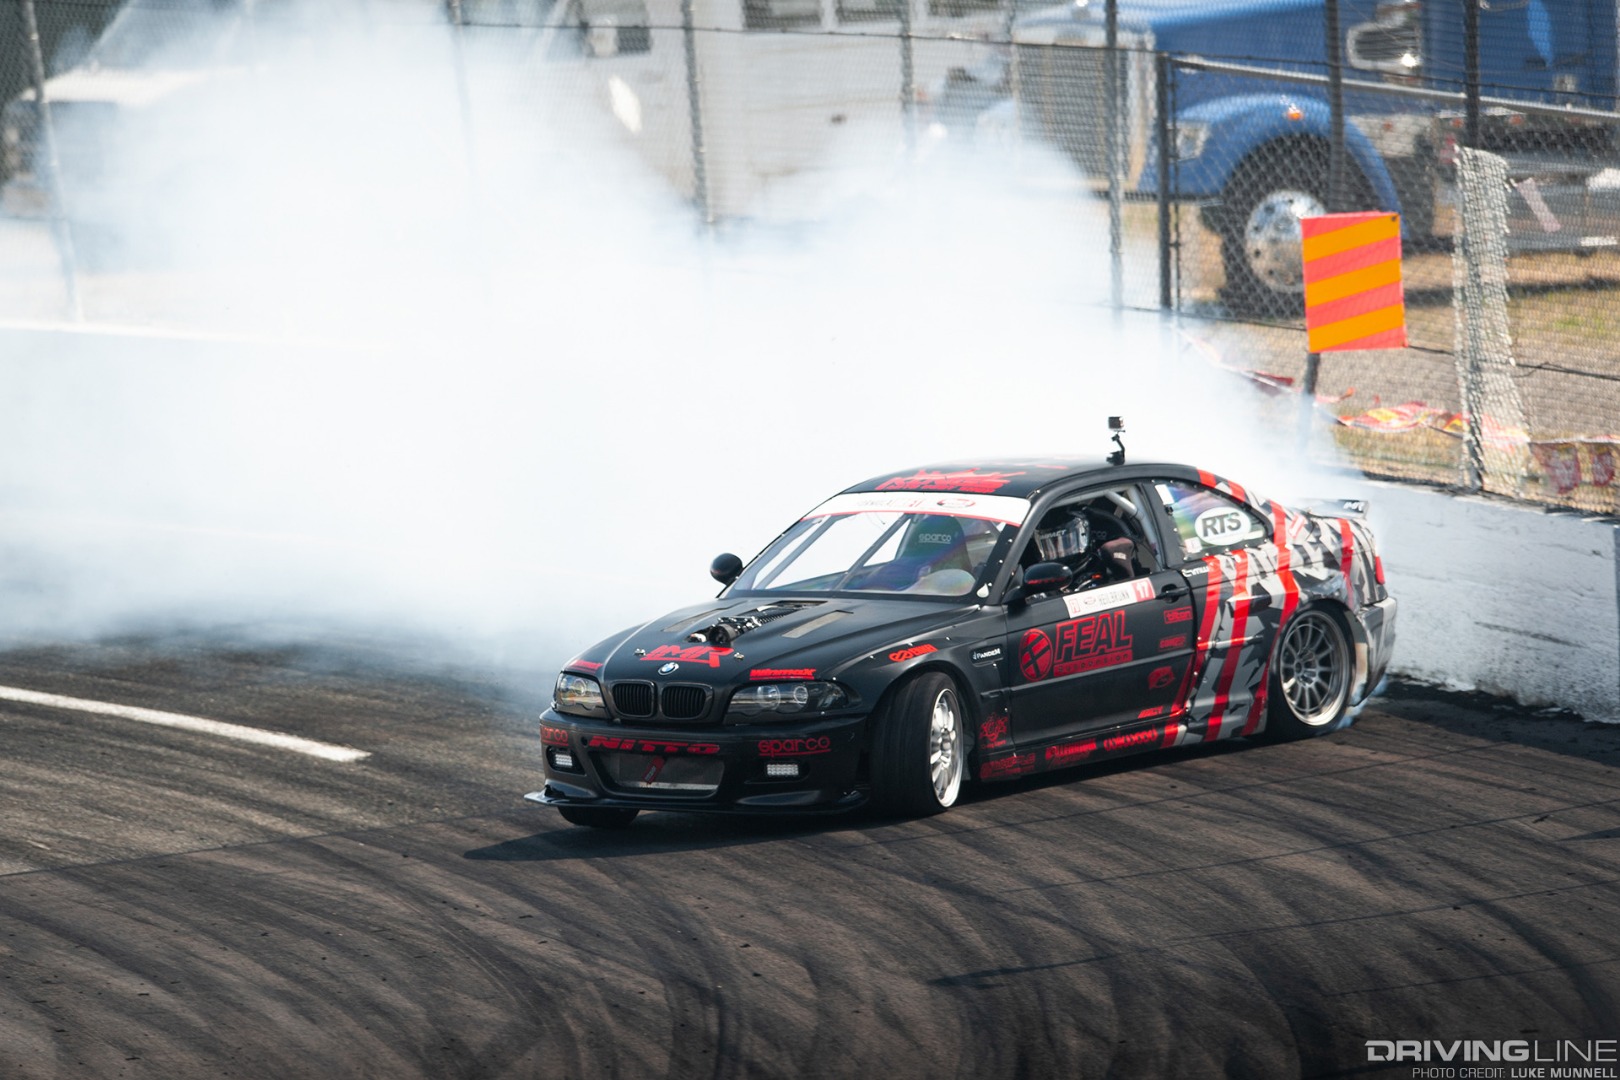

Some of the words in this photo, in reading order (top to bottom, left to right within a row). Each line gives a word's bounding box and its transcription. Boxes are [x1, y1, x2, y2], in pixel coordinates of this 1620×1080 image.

[1202, 512, 1242, 538] RTS
[918, 533, 952, 544] sparco
[1135, 578, 1150, 600] 17
[1054, 610, 1133, 663] FEAL
[589, 735, 720, 755] NITTO
[758, 736, 831, 757] sparco
